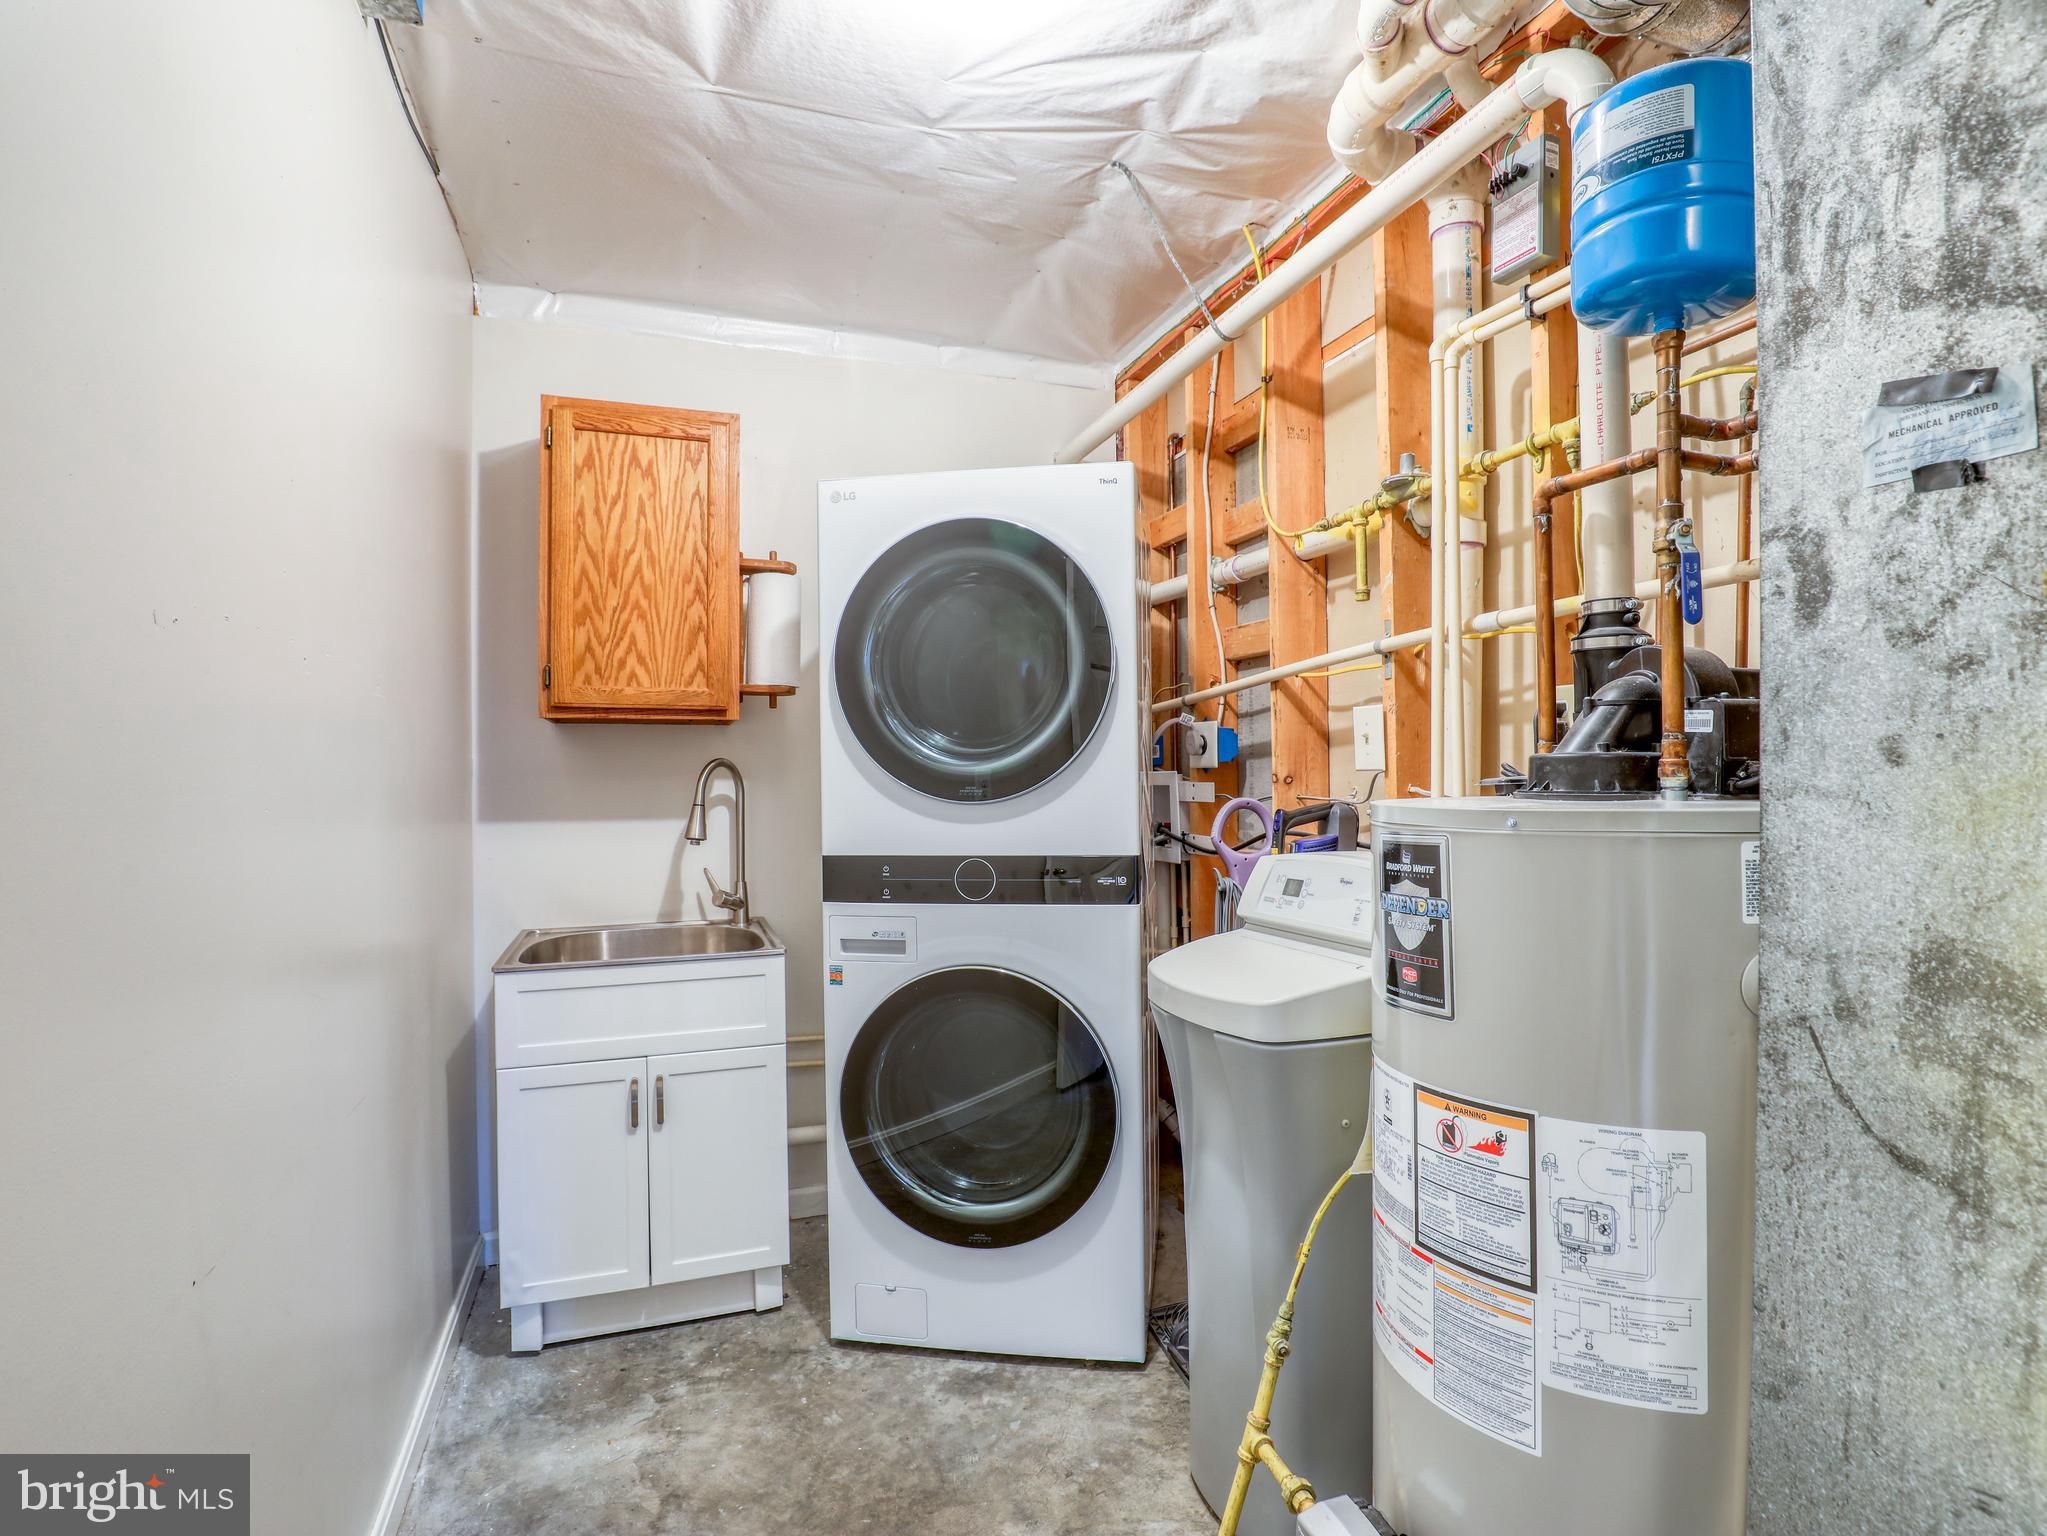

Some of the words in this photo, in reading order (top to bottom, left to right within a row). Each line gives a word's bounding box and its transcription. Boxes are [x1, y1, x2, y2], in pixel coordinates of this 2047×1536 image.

[1596, 383, 1604, 445] CHARLOTTE
[1888, 418, 1943, 439] MECHANICAL
[1949, 402, 1999, 422] APPROVED
[1098, 477, 1118, 486] ThinQ
[843, 491, 856, 501] LG
[1386, 861, 1411, 872] BRADFORD
[1412, 864, 1436, 874] WHITE
[1381, 891, 1450, 919] DEFENDER
[1407, 920, 1435, 932] SYSTEM
[1453, 1105, 1487, 1120] WARNING
[1598, 1128, 1617, 1136] WIRING
[1485, 1157, 1500, 1166] Vapors
[1453, 1160, 1476, 1172] EXPLOSION
[1477, 1168, 1496, 1178] HAZARD
[1470, 1284, 1481, 1292] YOUR
[1482, 1289, 1498, 1298] SAFETY
[1582, 1364, 1599, 1372] VOLTS
[1595, 1363, 1628, 1373] ELECTRICAL
[1629, 1368, 1649, 1376] RATING
